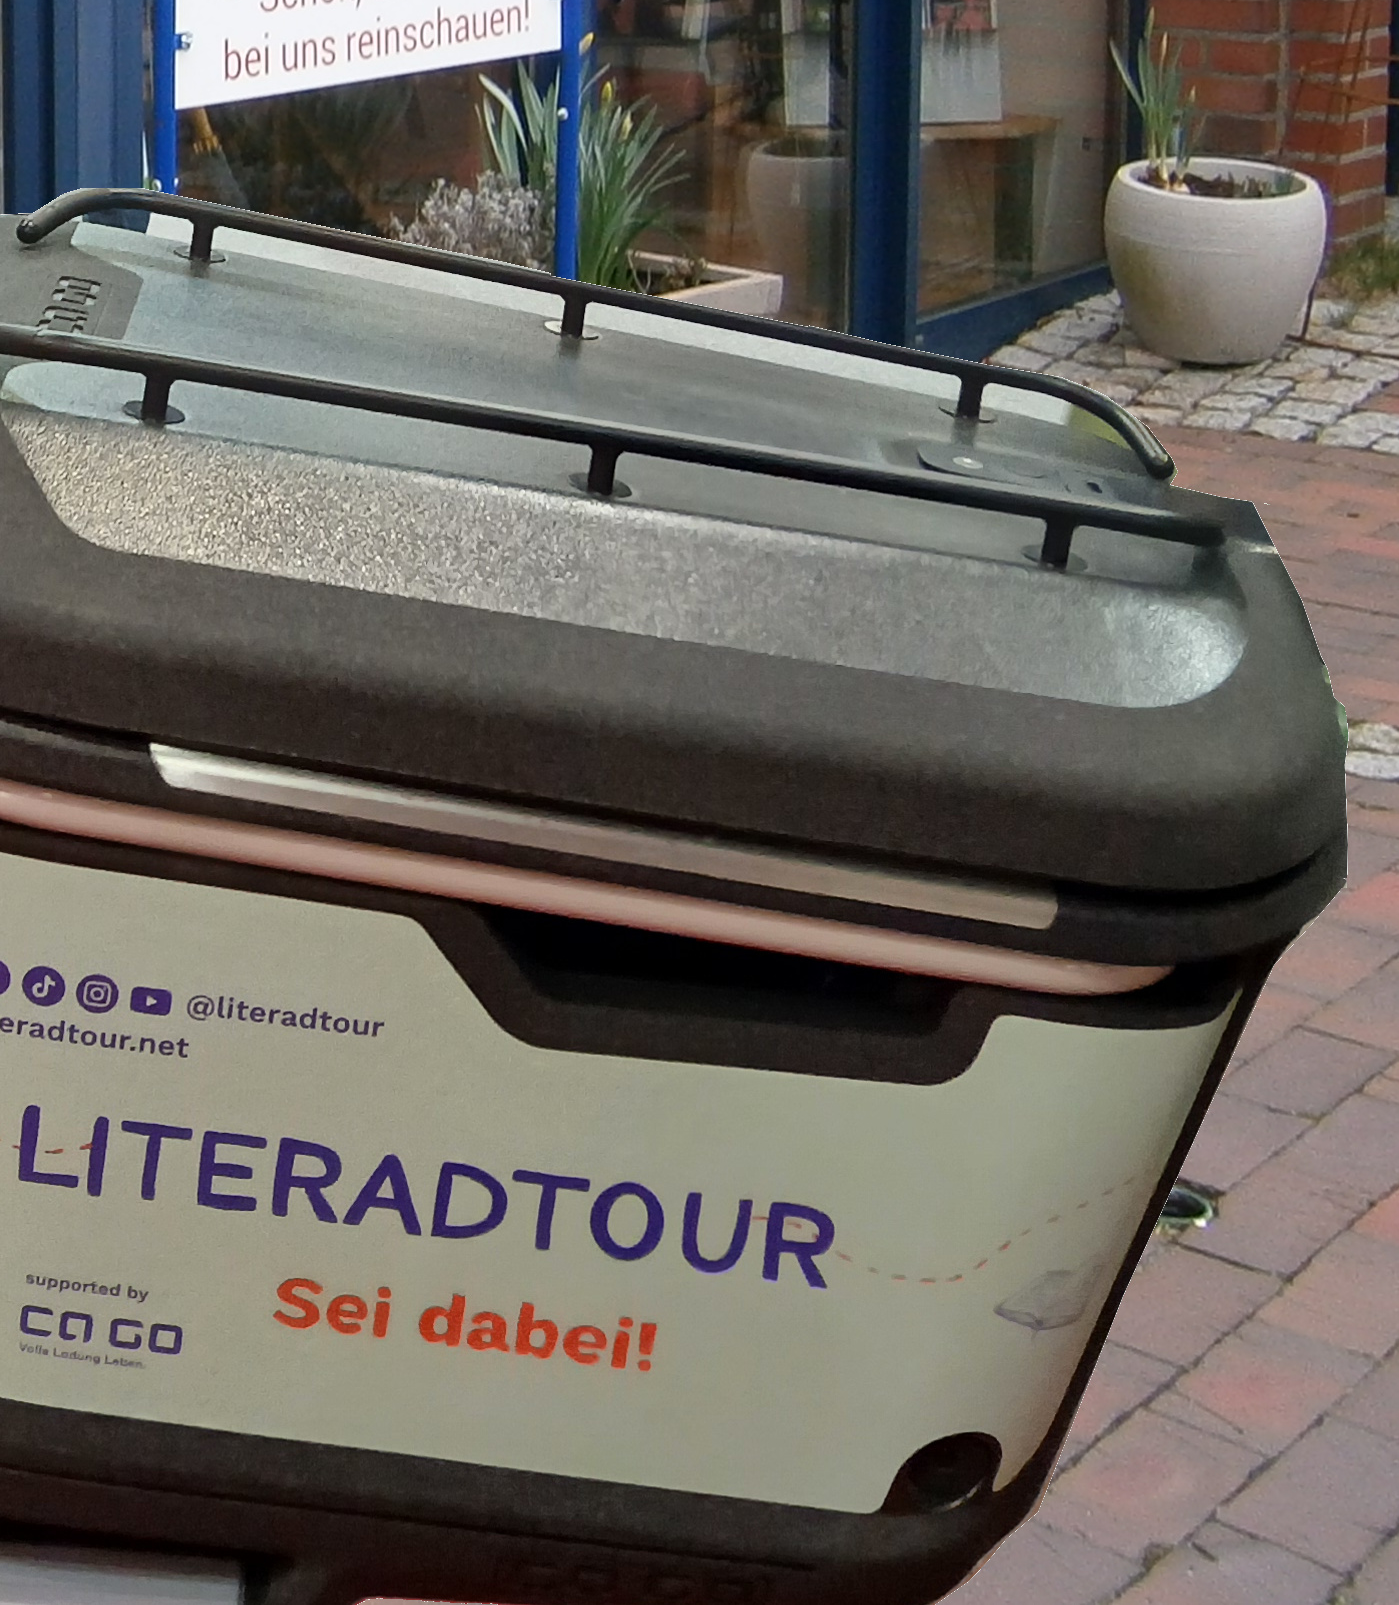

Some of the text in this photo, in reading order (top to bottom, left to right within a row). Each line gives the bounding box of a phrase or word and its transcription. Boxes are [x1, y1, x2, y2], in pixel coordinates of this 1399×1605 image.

[222, 32, 270, 81] bei
[280, 38, 337, 71] uns
[186, 995, 385, 1038] @literadtour
[17, 1104, 837, 1289] LITERADTOUR
[25, 1273, 149, 1303] supported by
[273, 1276, 658, 1372] Sei dabei!
